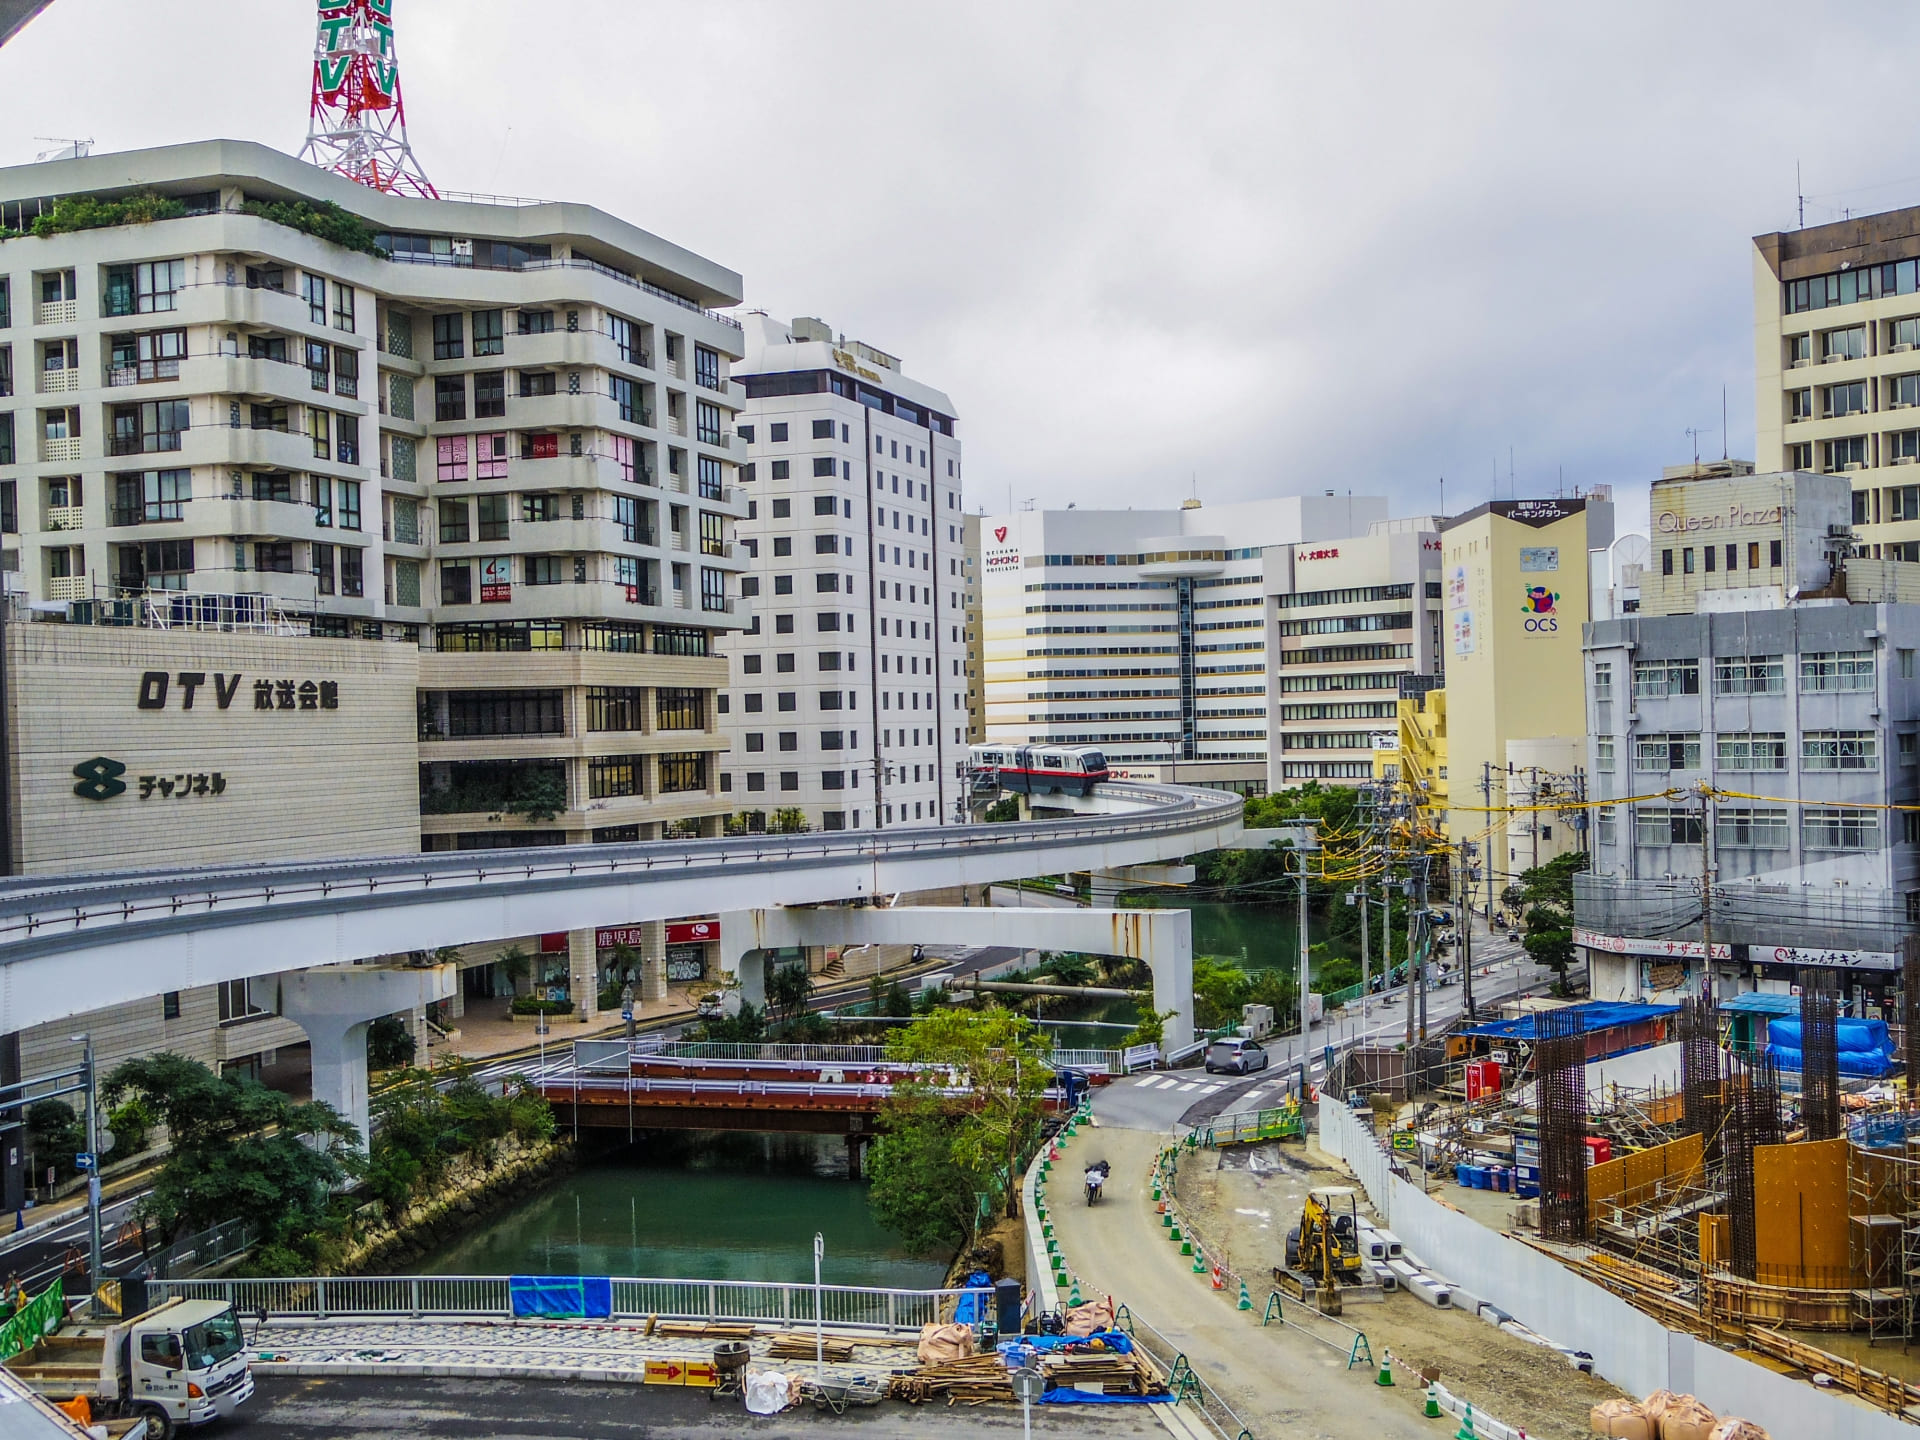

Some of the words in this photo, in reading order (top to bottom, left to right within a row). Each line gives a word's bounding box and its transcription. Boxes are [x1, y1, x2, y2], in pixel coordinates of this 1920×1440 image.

[1658, 511, 1724, 533] Queen
[1729, 503, 1783, 528] Plaza
[1524, 617, 1558, 633] OCS
[137, 671, 242, 710] OTV
[254, 679, 339, 710] 放送会館
[139, 772, 227, 800] チャンネル
